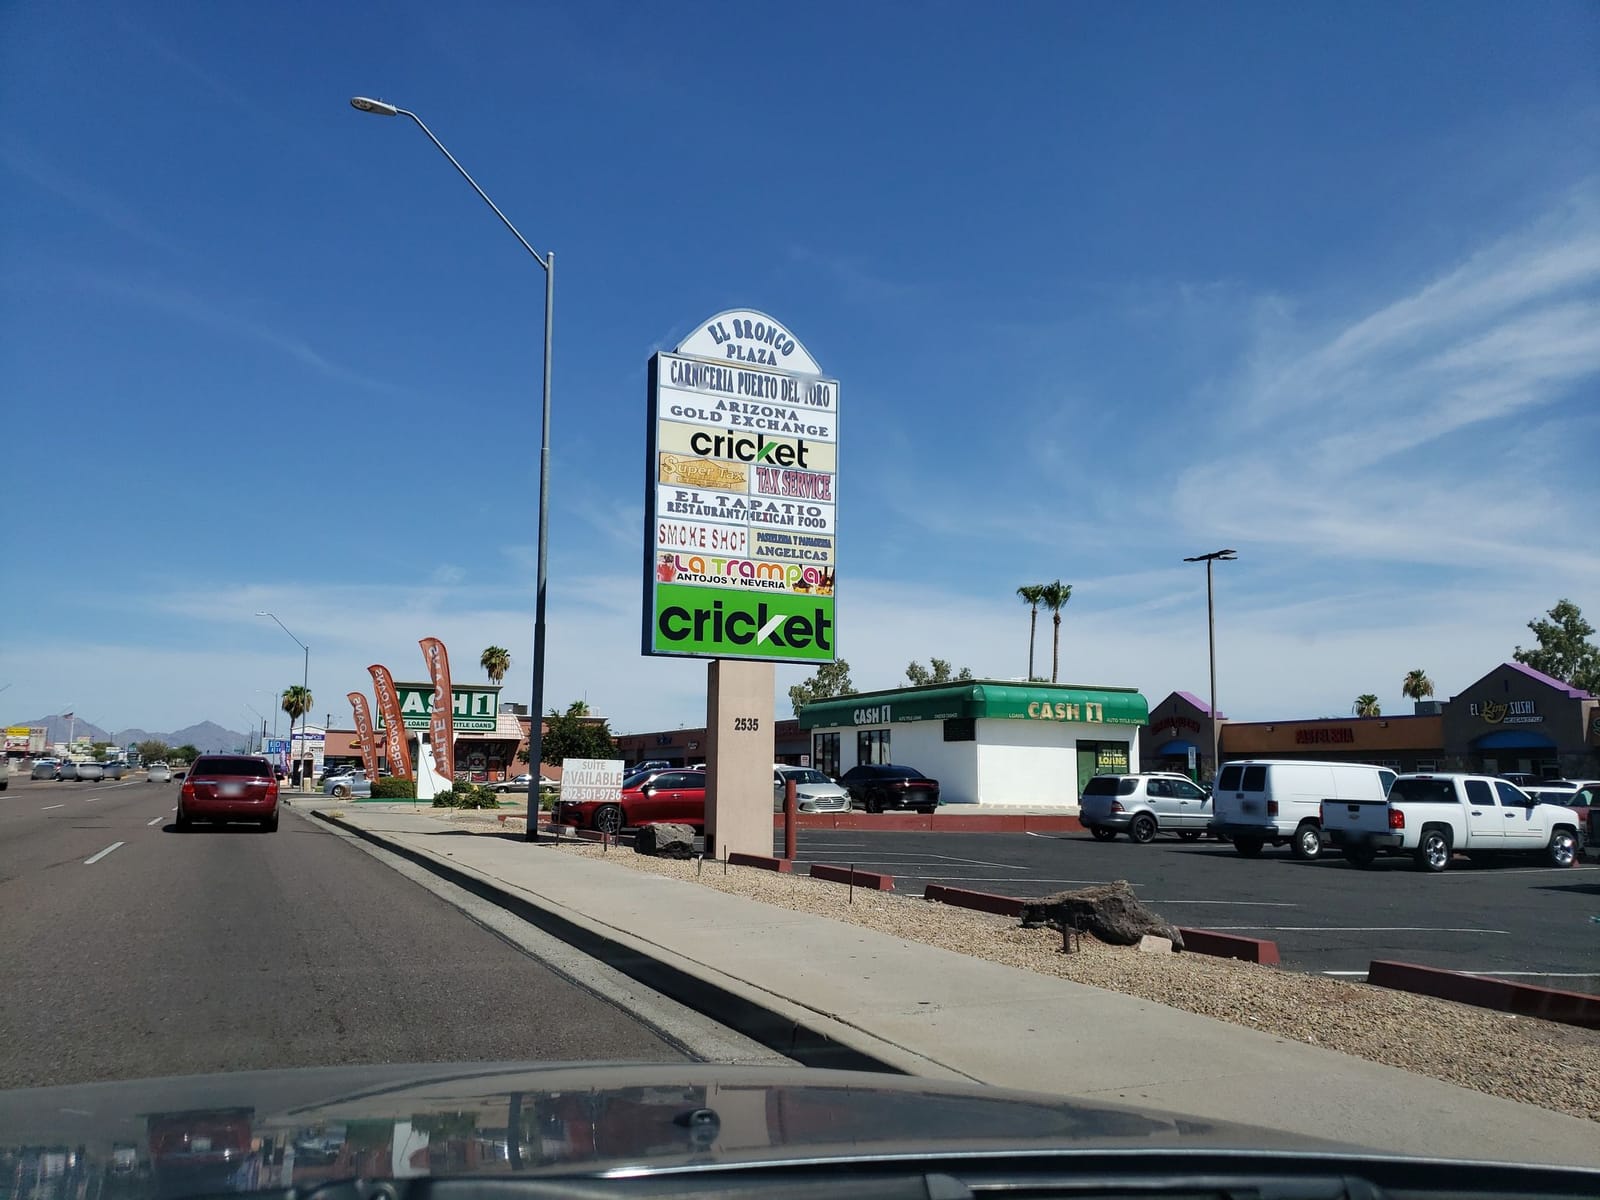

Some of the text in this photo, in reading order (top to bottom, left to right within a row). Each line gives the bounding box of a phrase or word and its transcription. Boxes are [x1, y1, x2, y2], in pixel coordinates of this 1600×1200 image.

[708, 318, 795, 356] EL BRONCO
[726, 343, 777, 366] PLAZA
[670, 360, 734, 393] CARNICERIA
[737, 373, 778, 400] PUERTO
[781, 378, 800, 402] DEL
[670, 405, 829, 437] GOLD EXCHANGE
[715, 399, 800, 421] ARIZONA
[690, 429, 809, 468] cricket
[663, 455, 745, 481] Super Tax
[756, 467, 782, 495] TAX
[782, 470, 832, 501] SERVICE
[675, 490, 822, 517] EL TAPATIO
[798, 516, 827, 529] FOOD
[658, 523, 746, 551] SMOKE SHOP
[756, 545, 828, 561] ANGELICAS
[676, 573, 786, 589] ANTOJOS Y NEVERIA
[659, 600, 832, 651] cricket
[853, 708, 880, 724] CASH
[1027, 701, 1080, 721] CASH
[1470, 703, 1479, 716] EL
[1510, 700, 1535, 715] SUSHI
[734, 717, 759, 731] 2535
[582, 761, 606, 770] SUITE
[562, 771, 622, 786] AVAILABLE
